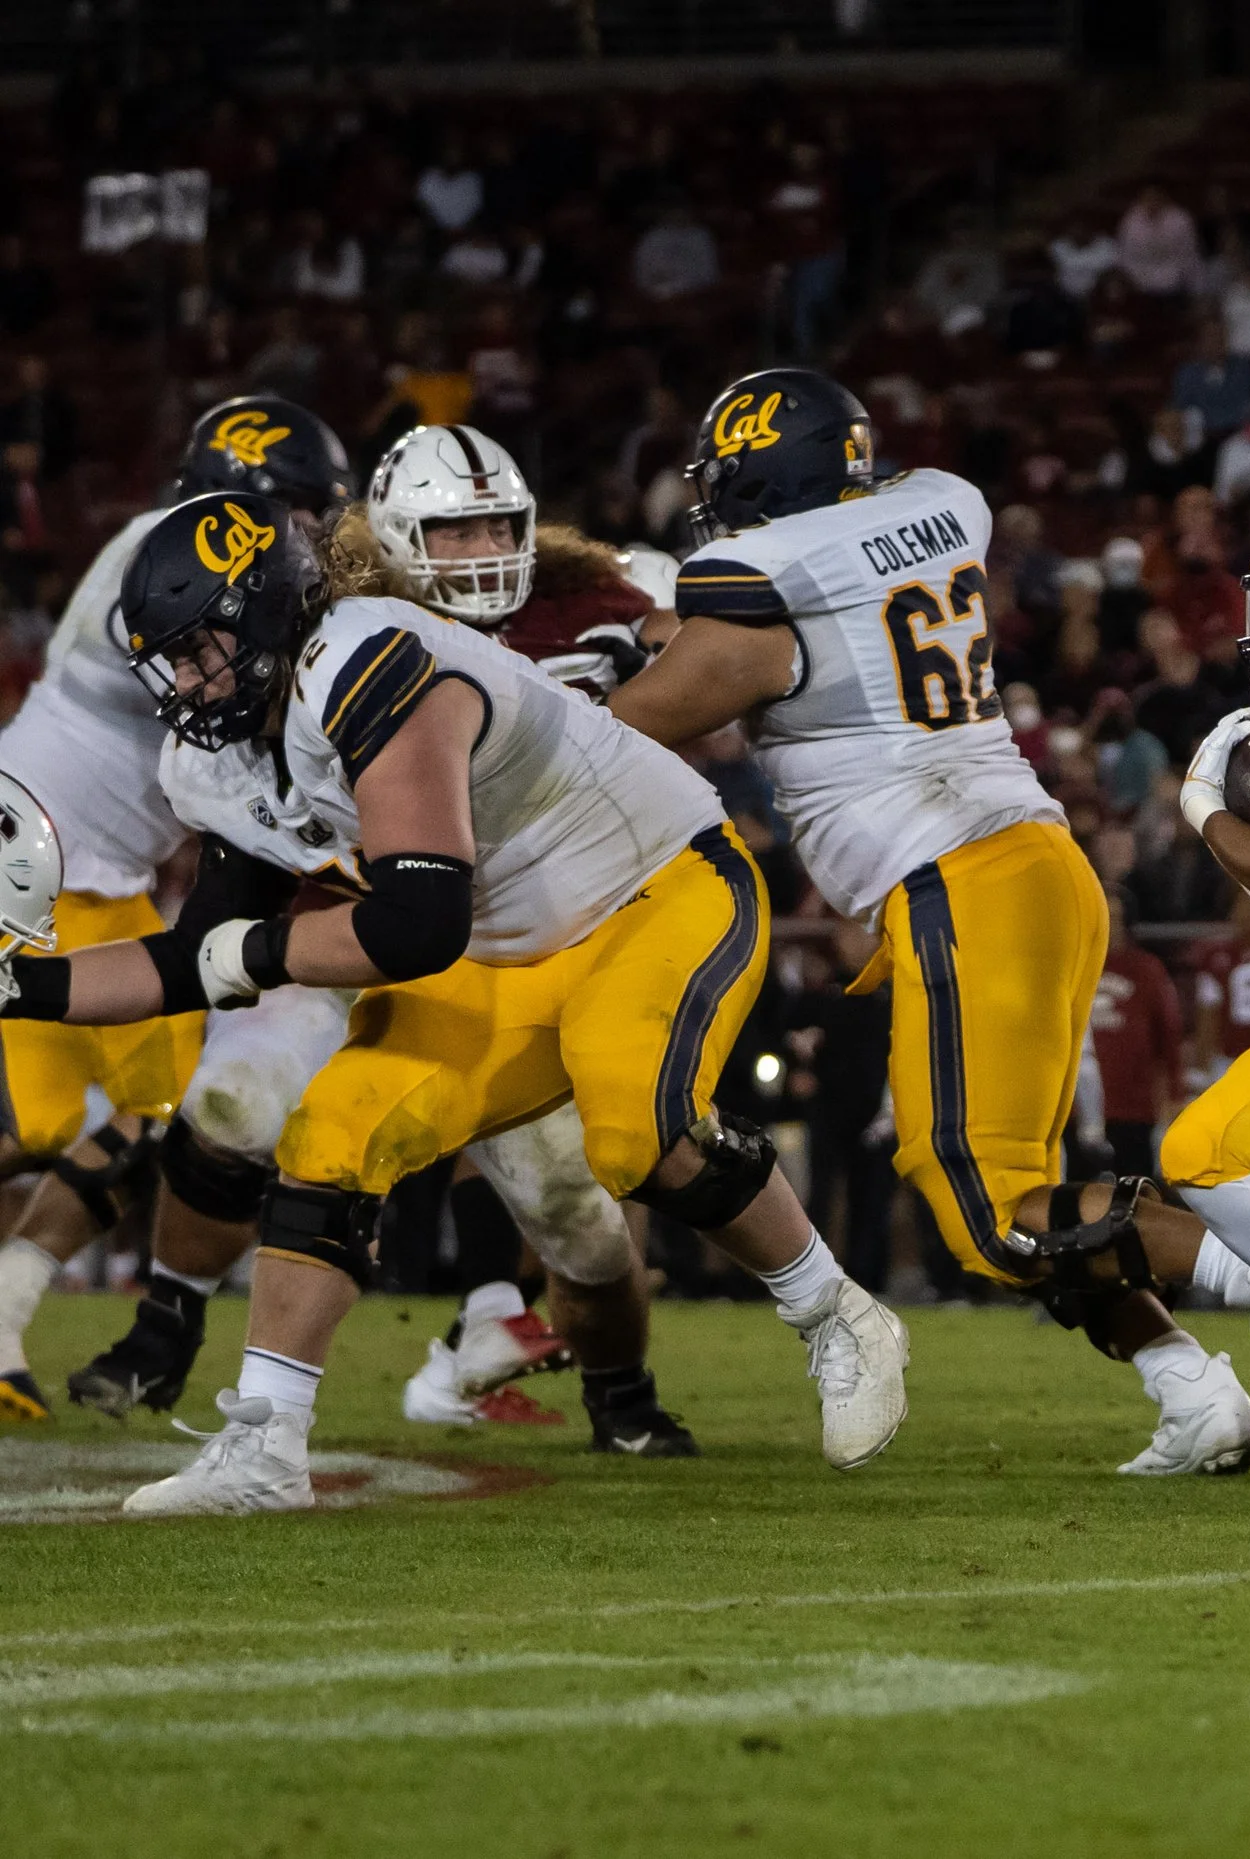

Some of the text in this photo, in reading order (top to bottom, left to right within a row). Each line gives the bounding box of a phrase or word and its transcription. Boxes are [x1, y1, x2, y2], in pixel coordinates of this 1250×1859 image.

[208, 411, 292, 467] Cal
[714, 391, 781, 459] Cal
[195, 502, 276, 587] Cal
[861, 510, 969, 576] COLEMAN
[880, 560, 1004, 732] 62
